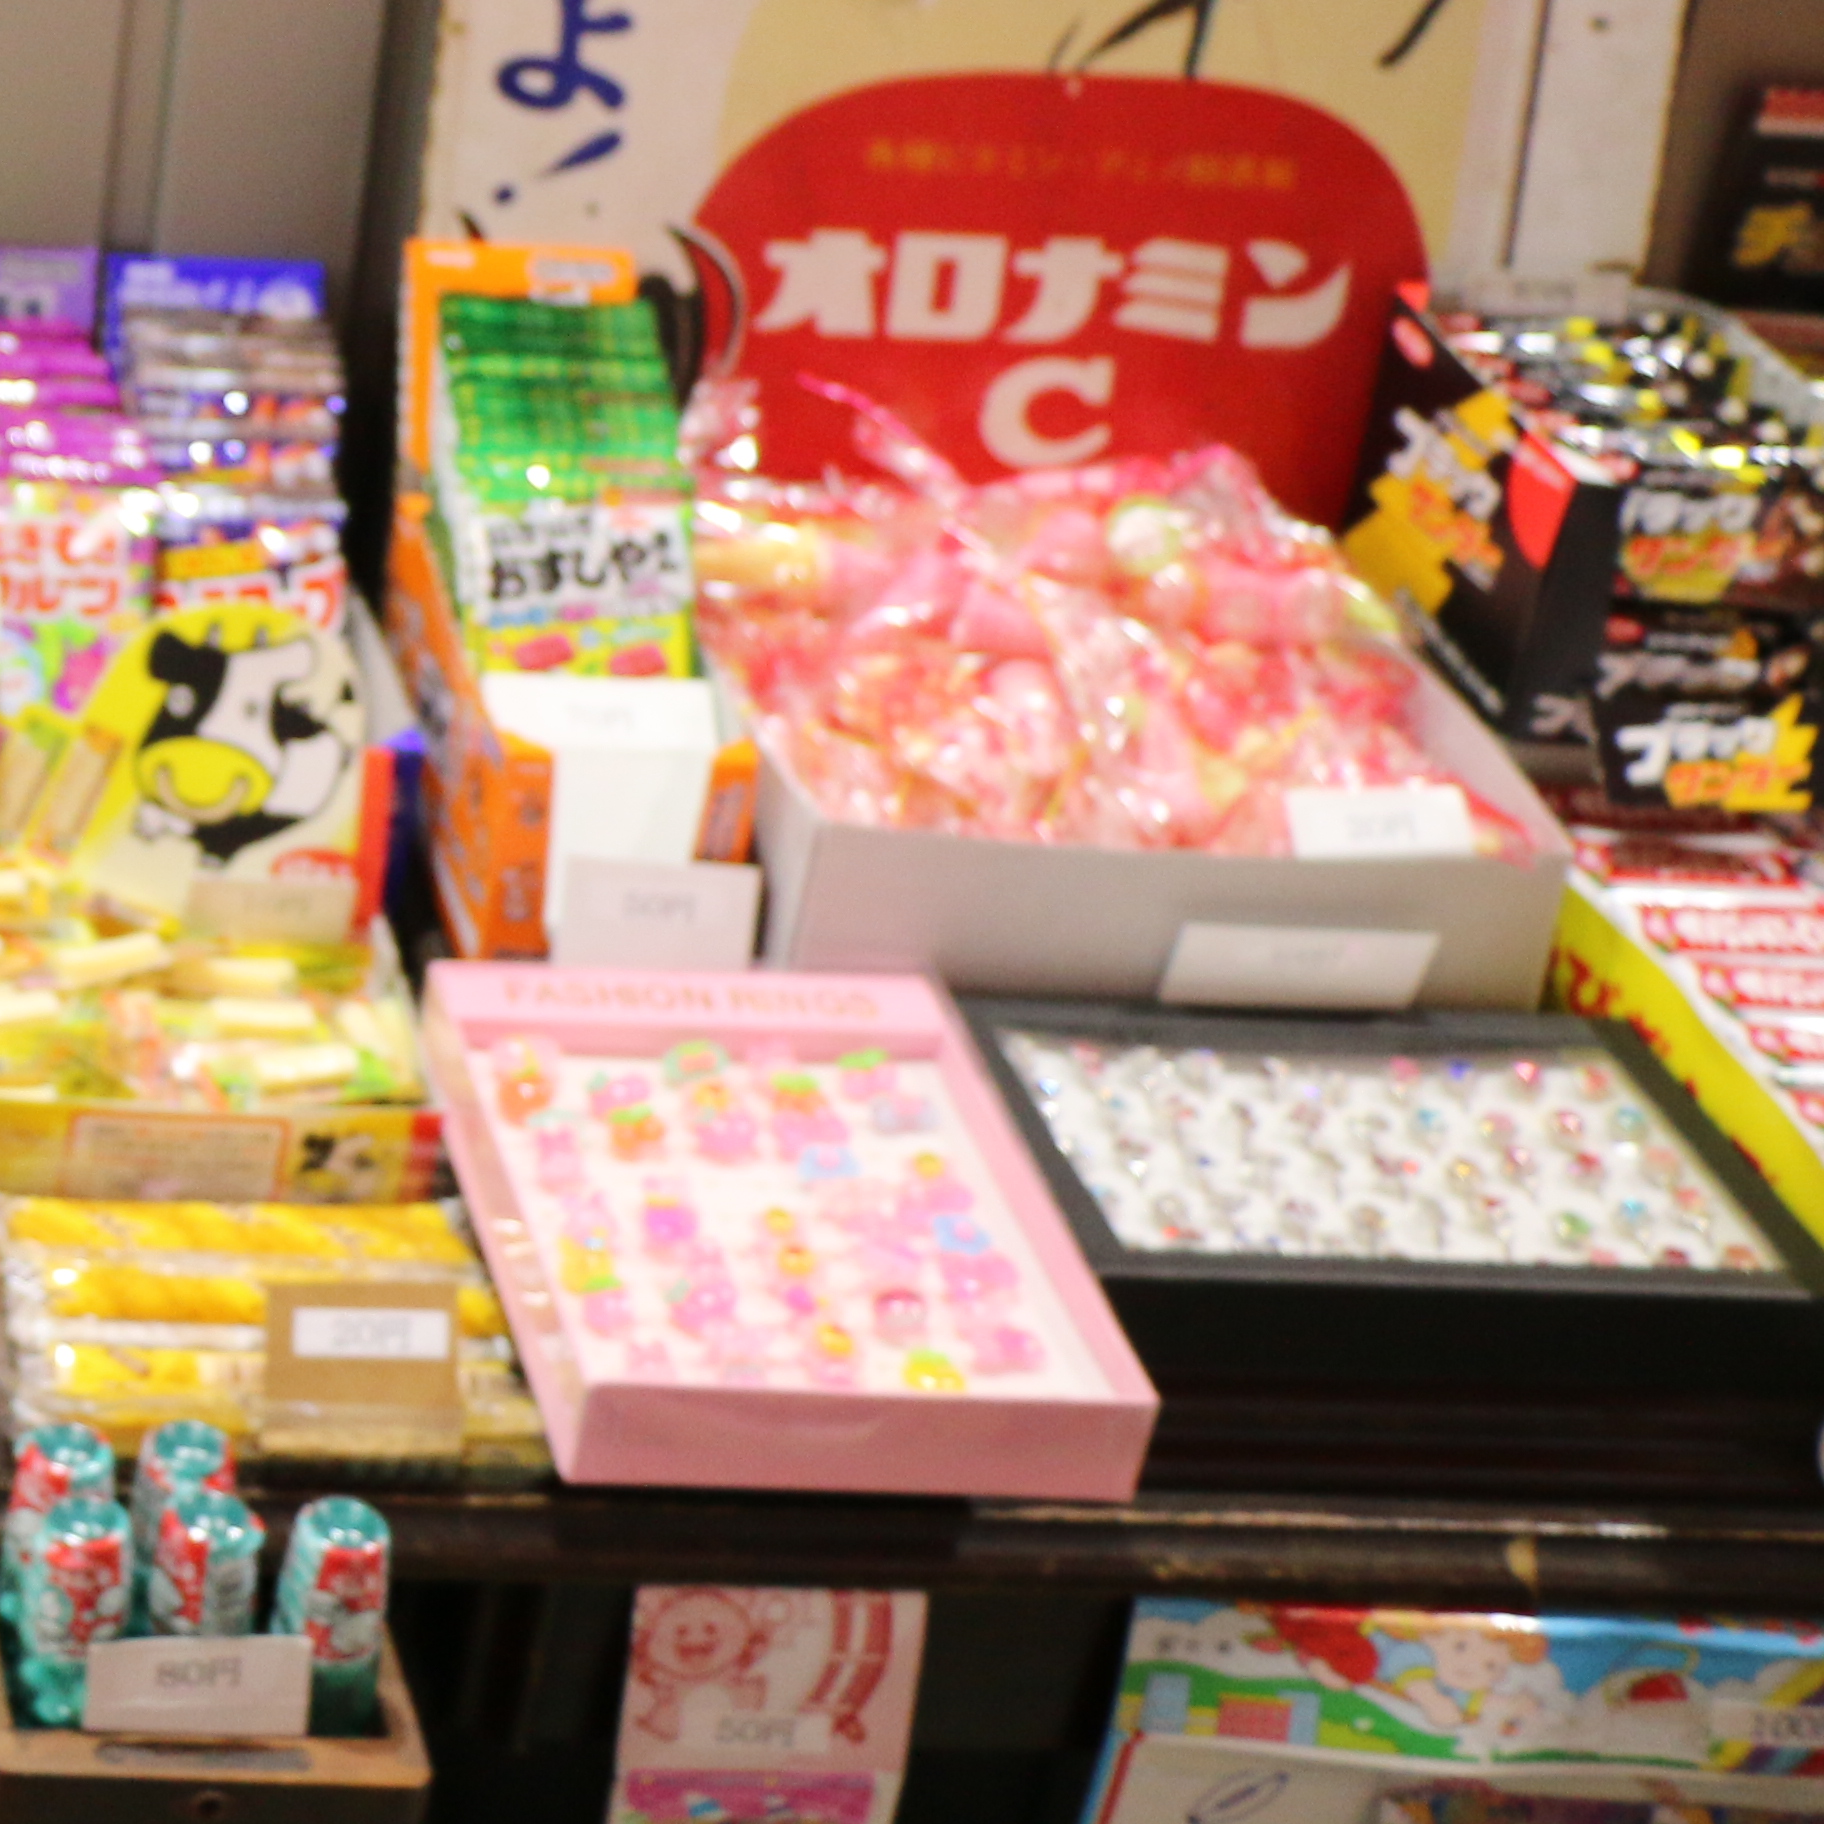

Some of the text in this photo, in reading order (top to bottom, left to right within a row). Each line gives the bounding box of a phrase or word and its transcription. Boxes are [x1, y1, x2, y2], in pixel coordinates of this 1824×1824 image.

[754, 228, 1350, 348] オロナミン
[978, 356, 1116, 470] C
